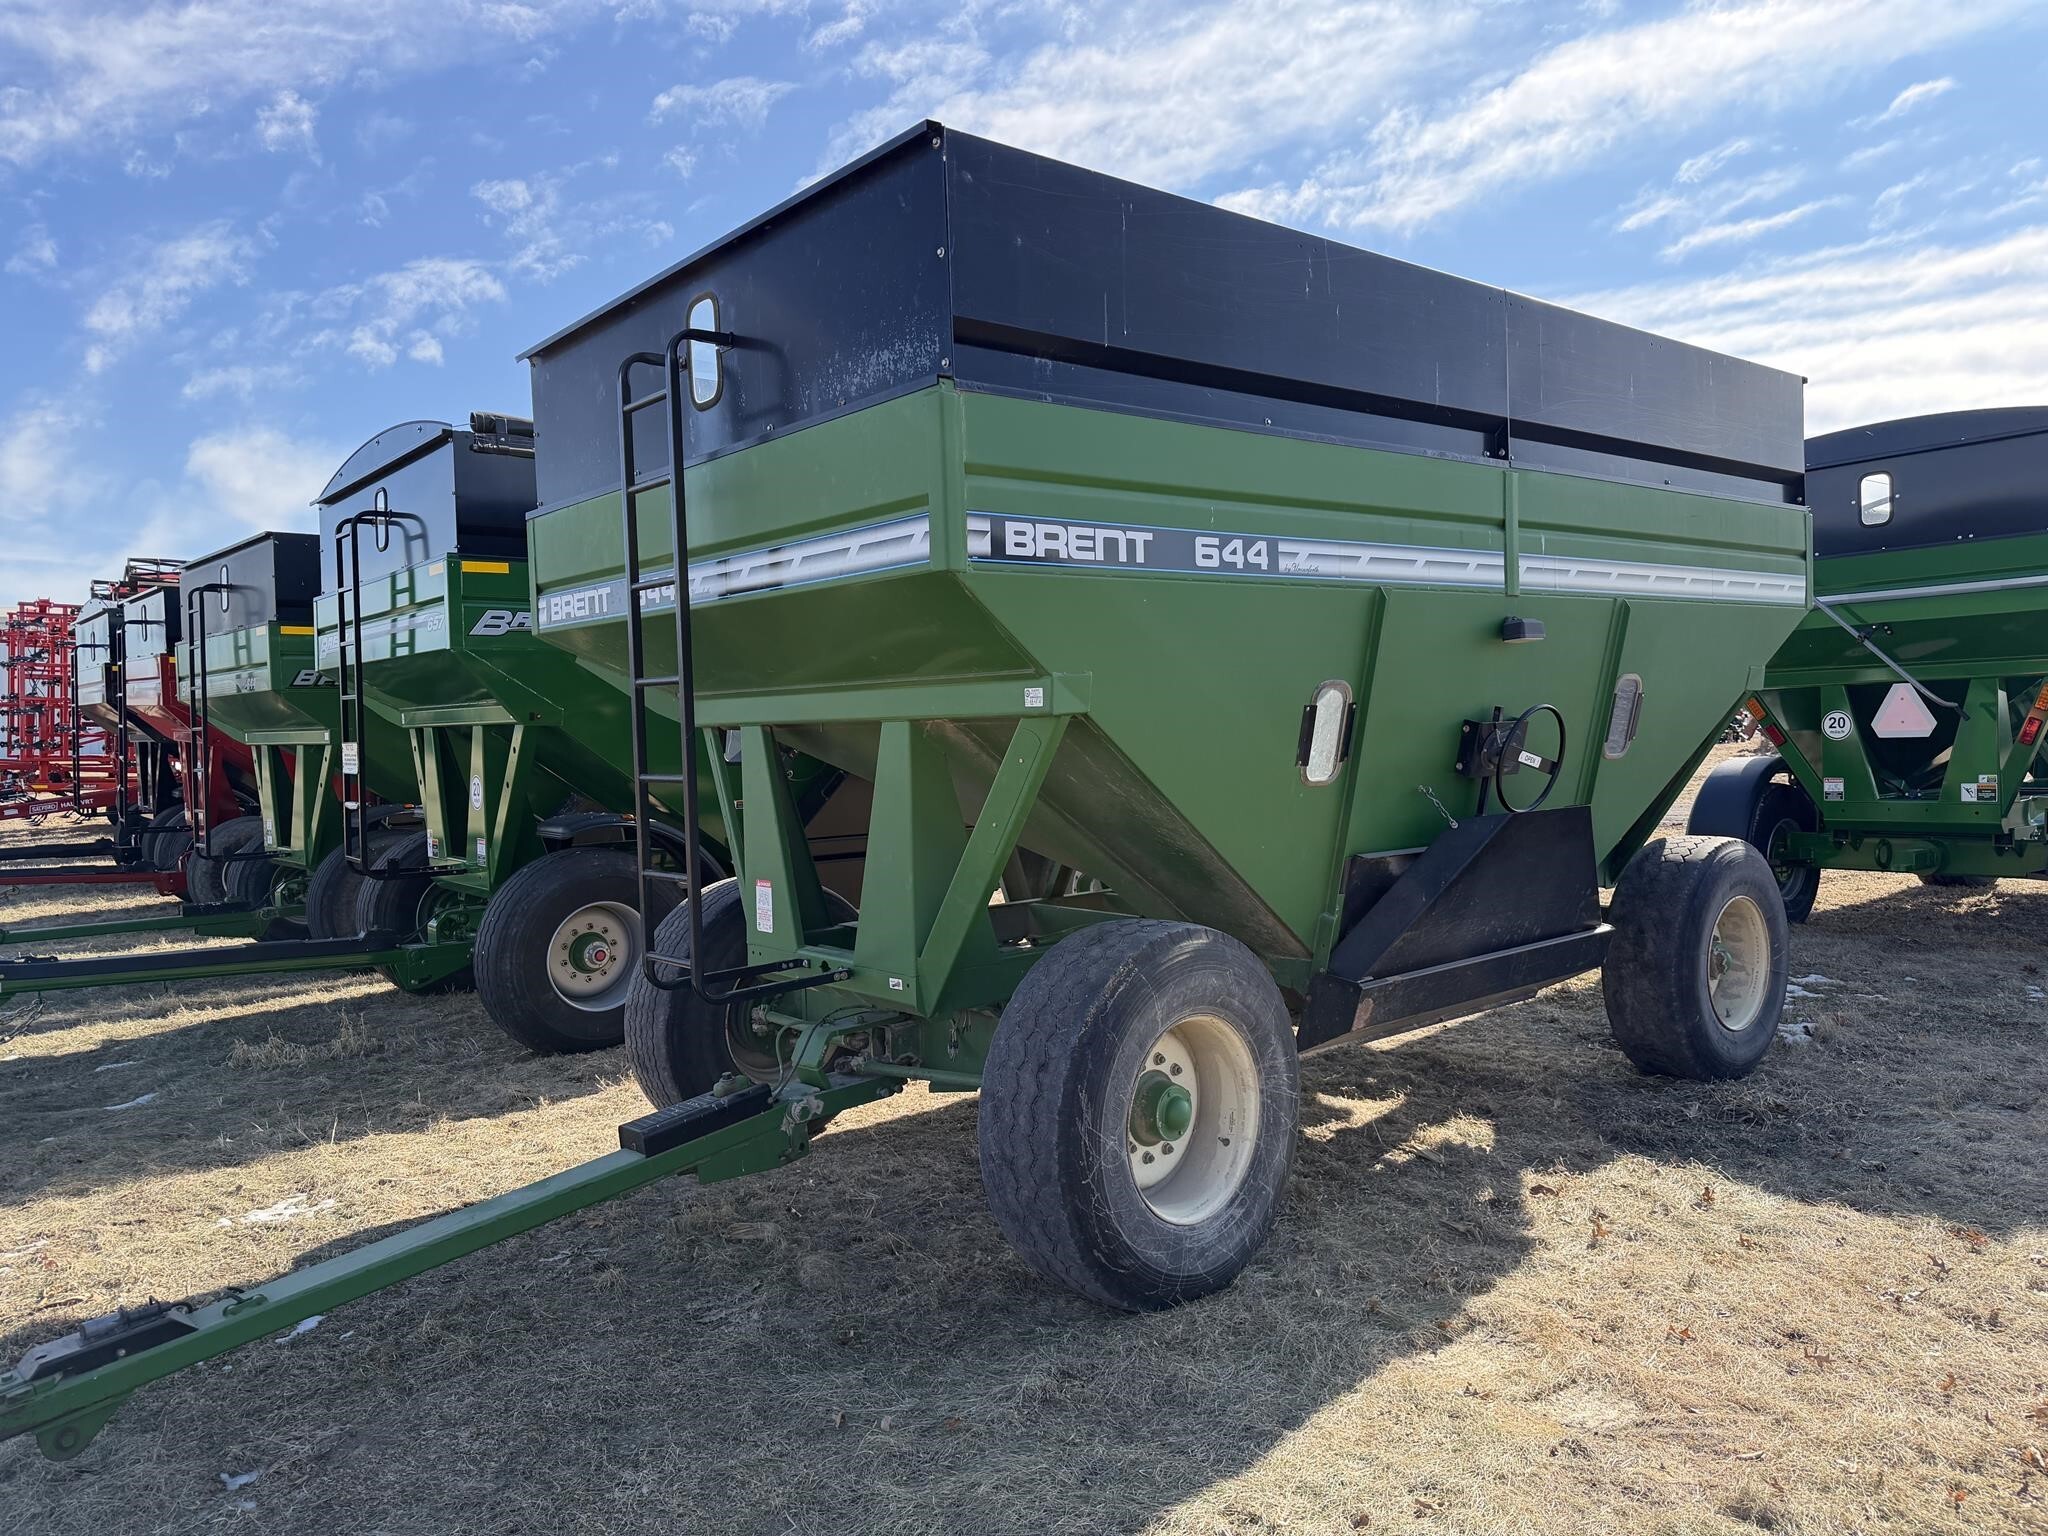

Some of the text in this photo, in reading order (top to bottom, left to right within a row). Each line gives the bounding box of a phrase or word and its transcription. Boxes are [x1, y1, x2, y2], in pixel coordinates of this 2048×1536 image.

[1004, 520, 1269, 570] BRENT 644
[550, 586, 611, 622] BRENT
[427, 614, 445, 632] 657
[1828, 716, 1846, 729] 20
